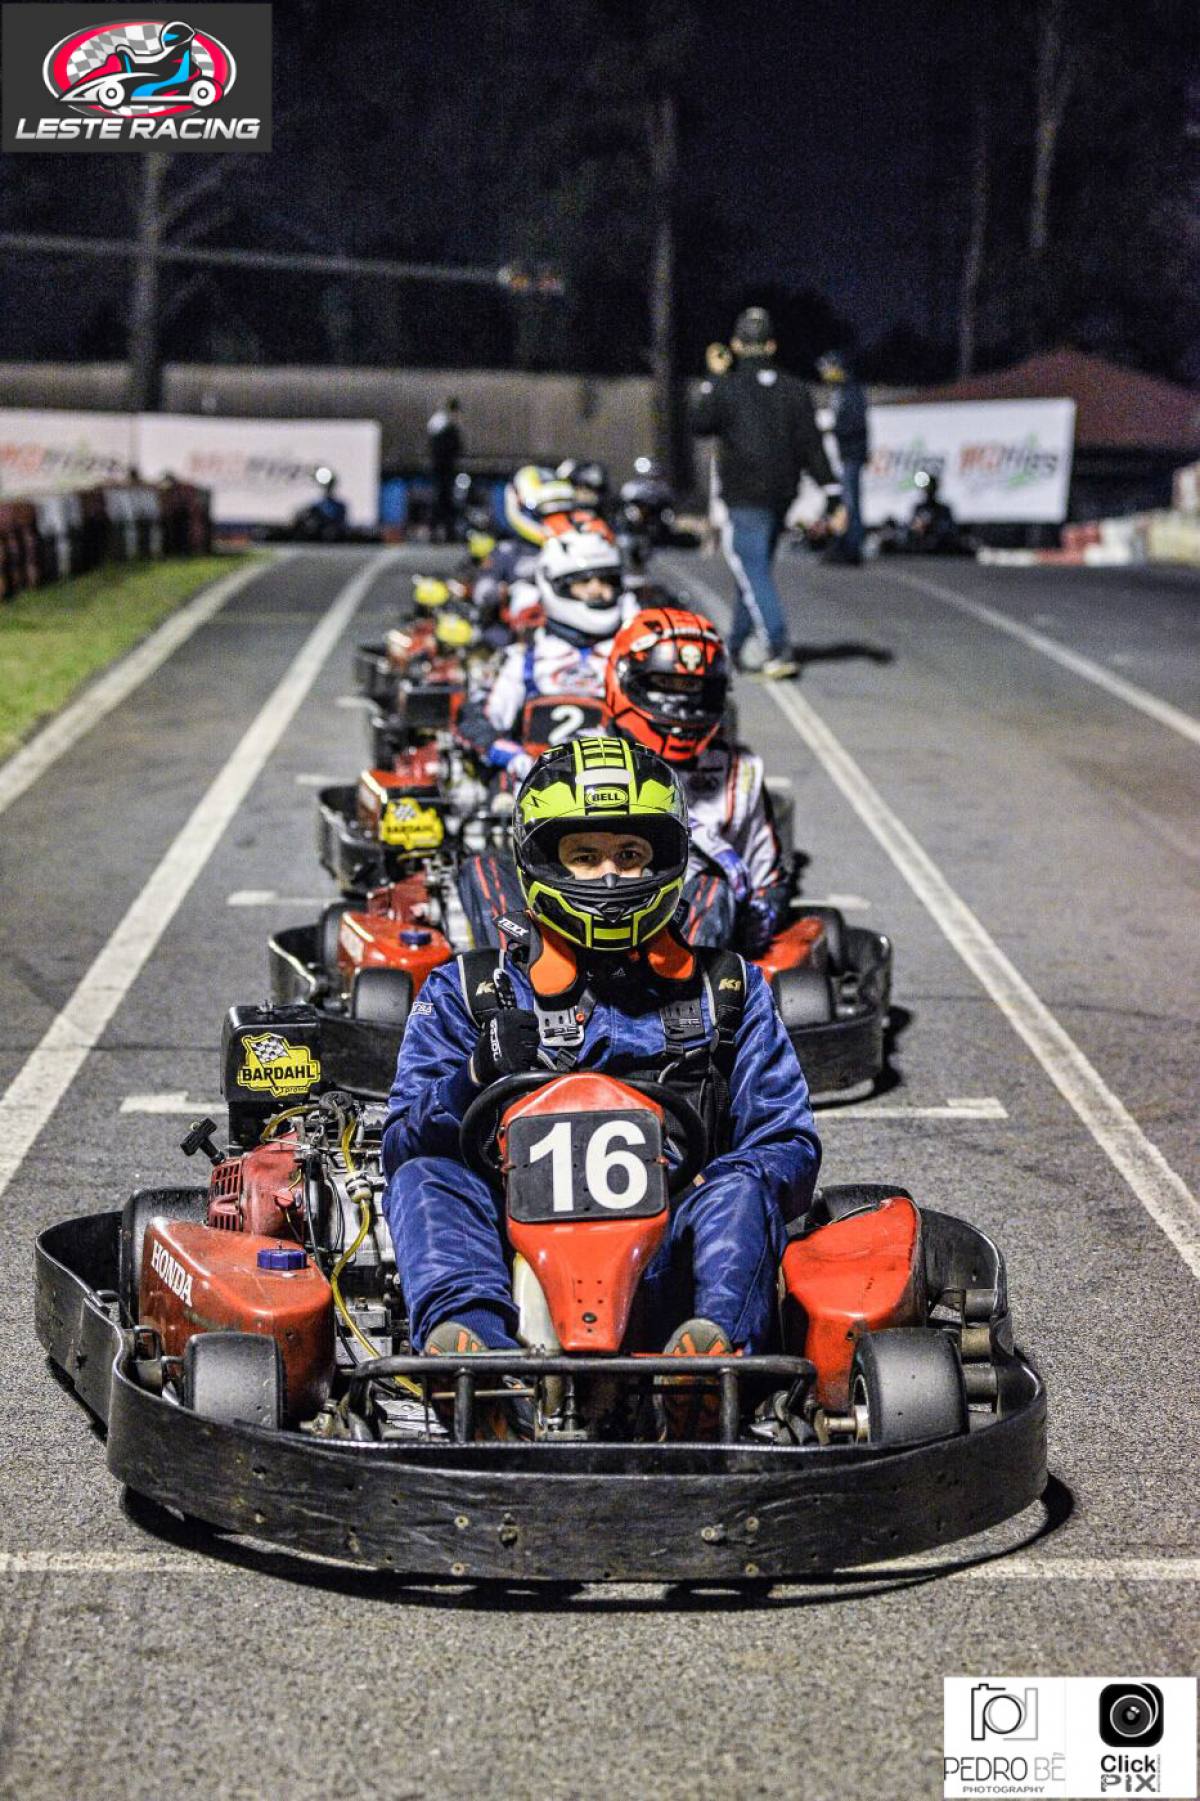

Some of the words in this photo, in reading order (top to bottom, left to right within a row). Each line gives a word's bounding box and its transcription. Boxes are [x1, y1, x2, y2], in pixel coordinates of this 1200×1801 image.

[548, 704, 584, 746] 2
[592, 793, 622, 801] BELL
[242, 1064, 315, 1081] BARDAHL
[529, 1120, 648, 1212] 16
[151, 1239, 194, 1308] HONDA
